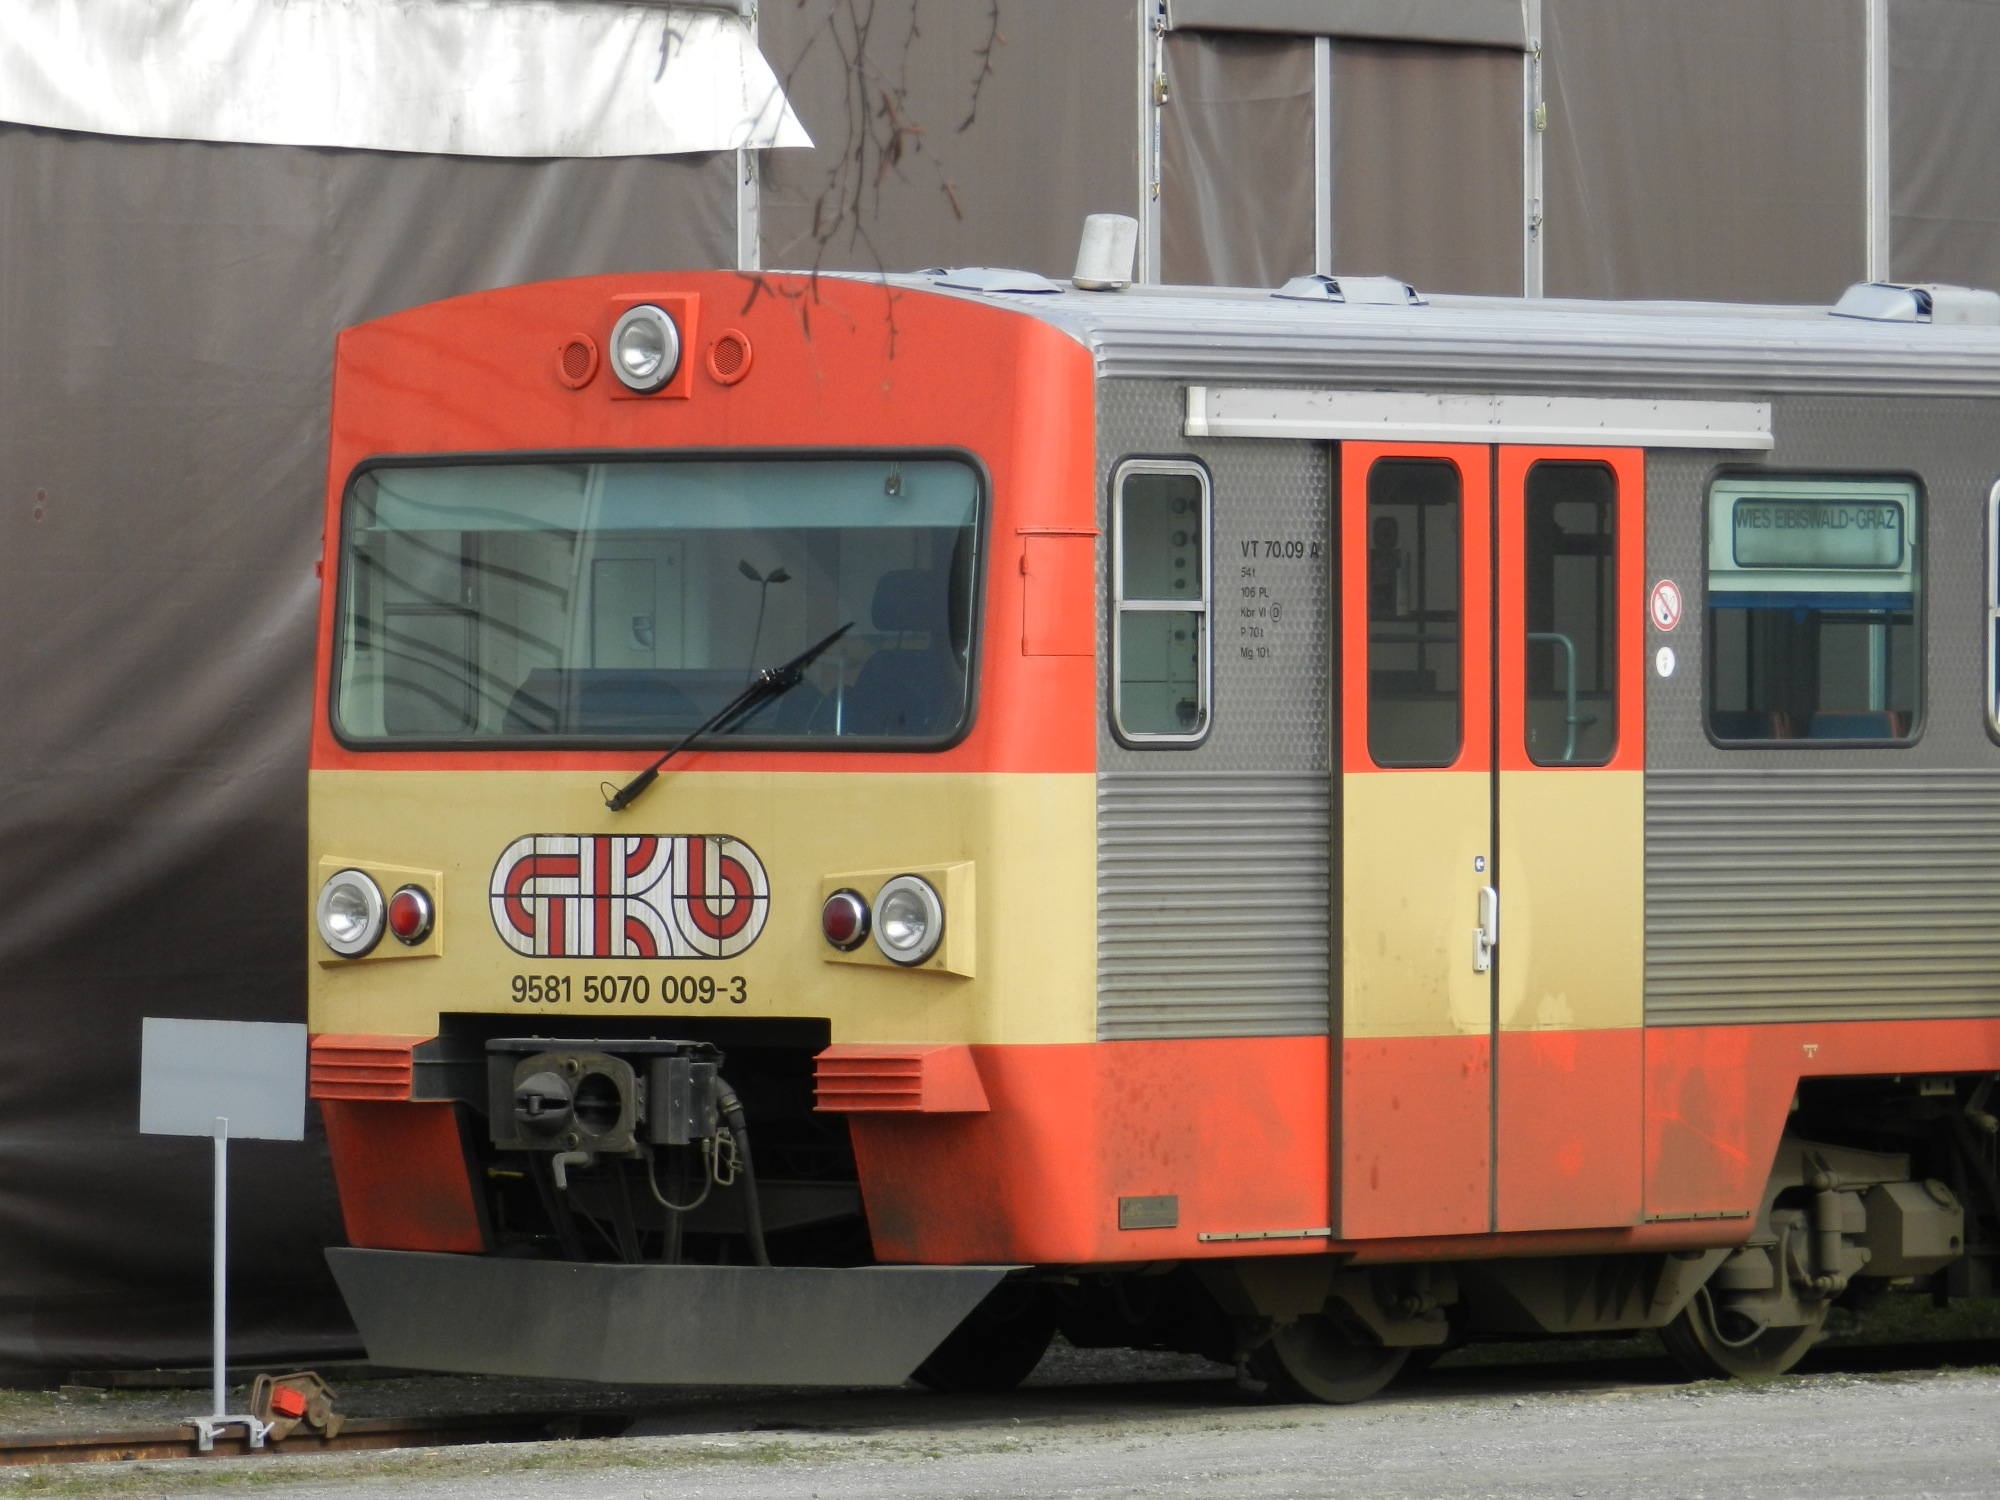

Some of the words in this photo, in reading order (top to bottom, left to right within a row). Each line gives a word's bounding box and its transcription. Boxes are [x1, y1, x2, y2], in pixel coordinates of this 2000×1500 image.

[1736, 508, 1772, 529] WIES
[1241, 540, 1259, 558] VT
[1264, 540, 1304, 559] 70.09
[1310, 541, 1320, 558] A
[1241, 586, 1256, 598] 106
[1259, 587, 1269, 598] PL
[1241, 627, 1246, 637] P
[1240, 647, 1254, 660] Mg
[511, 975, 571, 1003] 9581
[583, 975, 650, 1003] 5070
[661, 976, 747, 1004] 009-3
